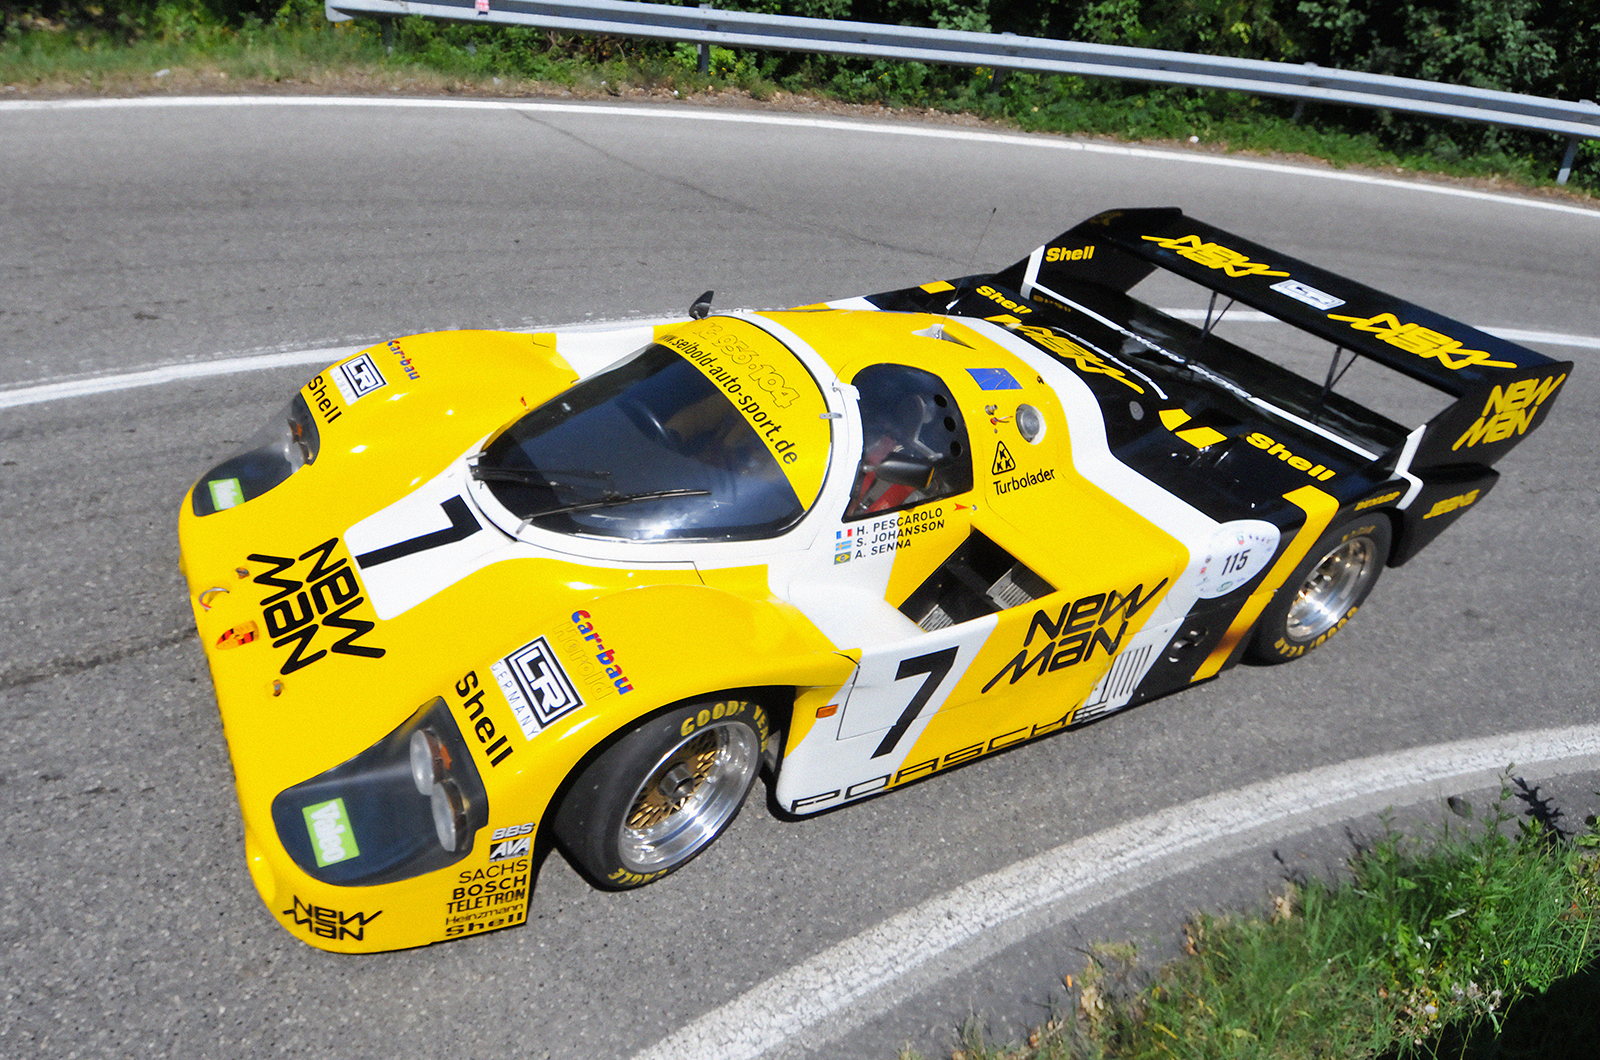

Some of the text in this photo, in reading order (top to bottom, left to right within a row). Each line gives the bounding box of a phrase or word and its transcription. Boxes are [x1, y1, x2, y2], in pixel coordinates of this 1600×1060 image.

[1045, 246, 1095, 262] Shell
[975, 284, 1033, 315] Shell
[308, 375, 342, 424] Shell
[1245, 432, 1336, 482] Shell
[993, 468, 1056, 495] Turbolader
[353, 494, 483, 570] 7
[856, 507, 943, 537] H. PESCAROLO
[856, 519, 945, 548] S. JOHANSSON
[854, 539, 911, 560] A. SENNA
[1221, 549, 1252, 576] 115
[571, 610, 634, 695] Car-bau
[516, 647, 567, 714] LR
[491, 661, 539, 738] GERMANY
[869, 645, 960, 760] 7
[456, 670, 514, 768] Shell
[491, 822, 535, 841] BBS
[490, 837, 531, 860] AVA
[459, 859, 528, 883] SACHS
[447, 888, 525, 914] TELETRON
[453, 874, 527, 900] BOSCH
[446, 912, 522, 936] Shell
